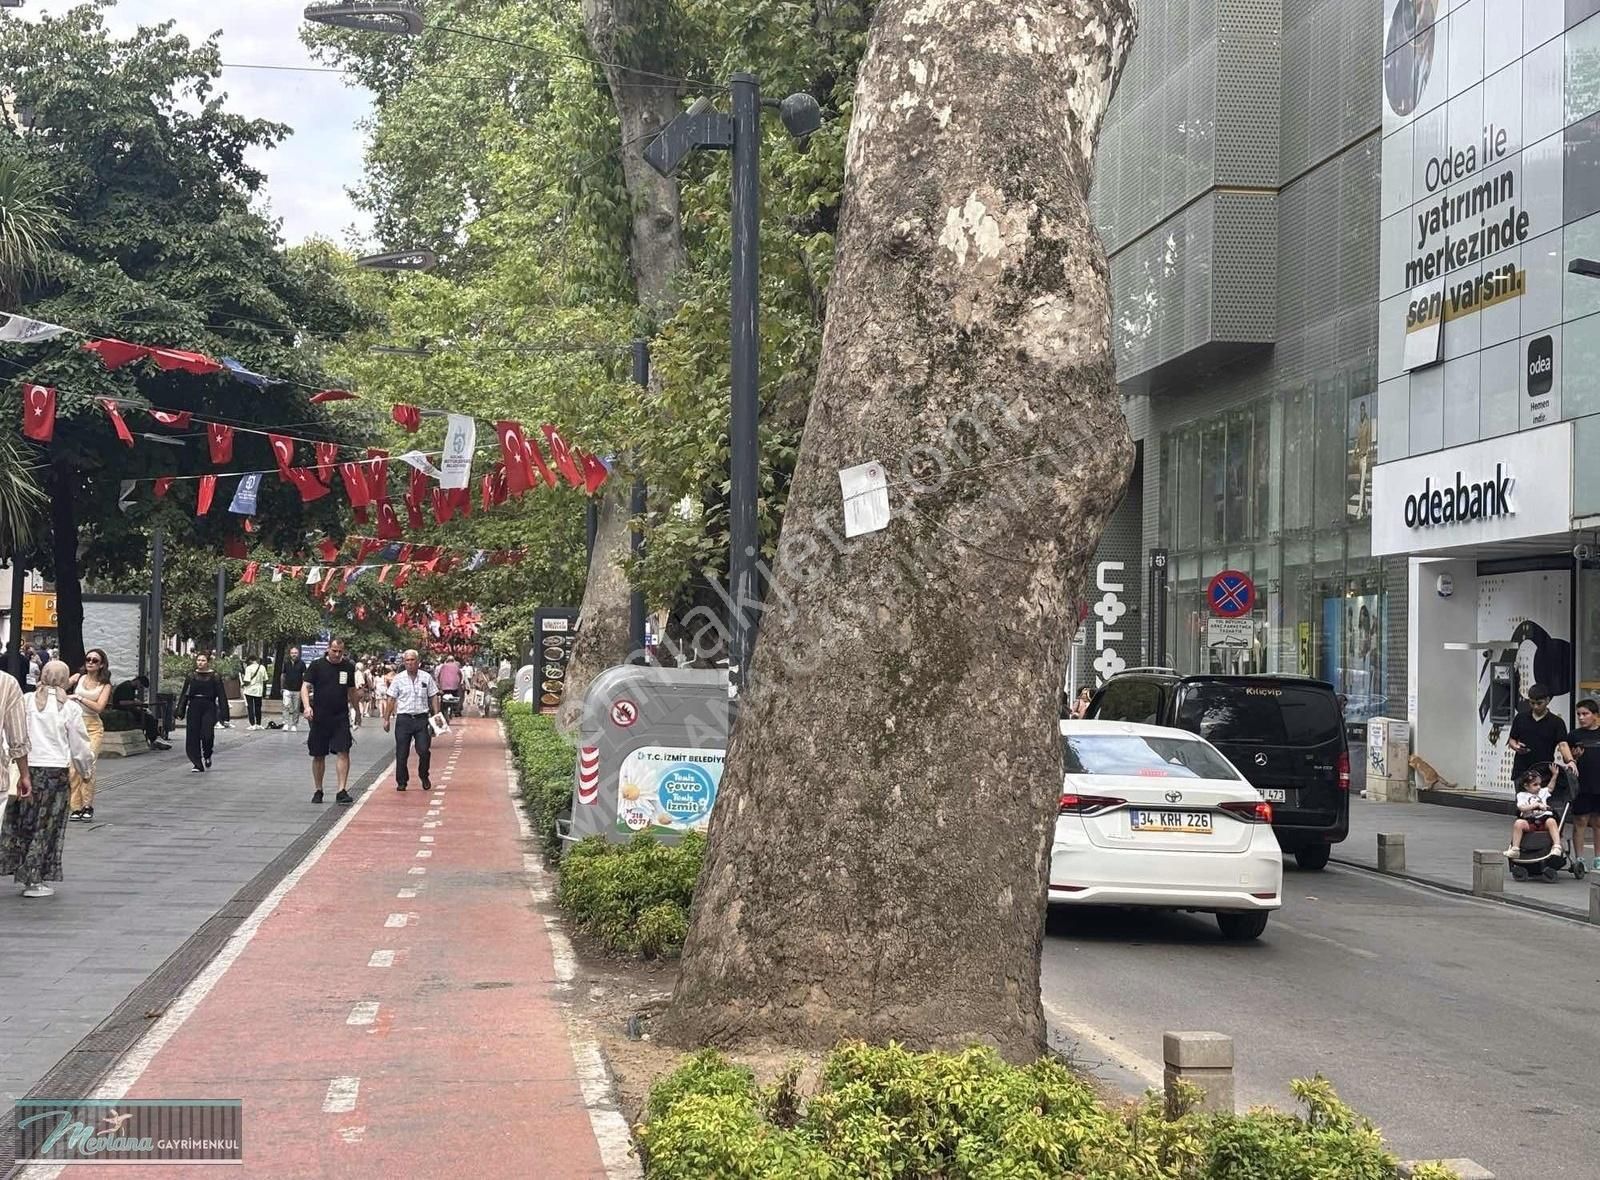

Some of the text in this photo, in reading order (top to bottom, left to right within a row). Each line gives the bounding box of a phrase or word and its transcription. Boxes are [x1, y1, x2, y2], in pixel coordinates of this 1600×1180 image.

[1425, 123, 1508, 192] Odea ile
[1417, 169, 1514, 250] yatırımın
[1405, 206, 1530, 288] merkezinde
[1407, 262, 1523, 328] sen varsın.
[1529, 355, 1551, 375] odea
[1530, 399, 1550, 412] Hemen
[1404, 462, 1514, 529] odeabank
[1093, 560, 1127, 688] OTON
[664, 754, 687, 762] İZMİT
[666, 781, 701, 793] Çevre
[1268, 790, 1284, 800] 473
[1140, 812, 1208, 828] 34 KRH 226
